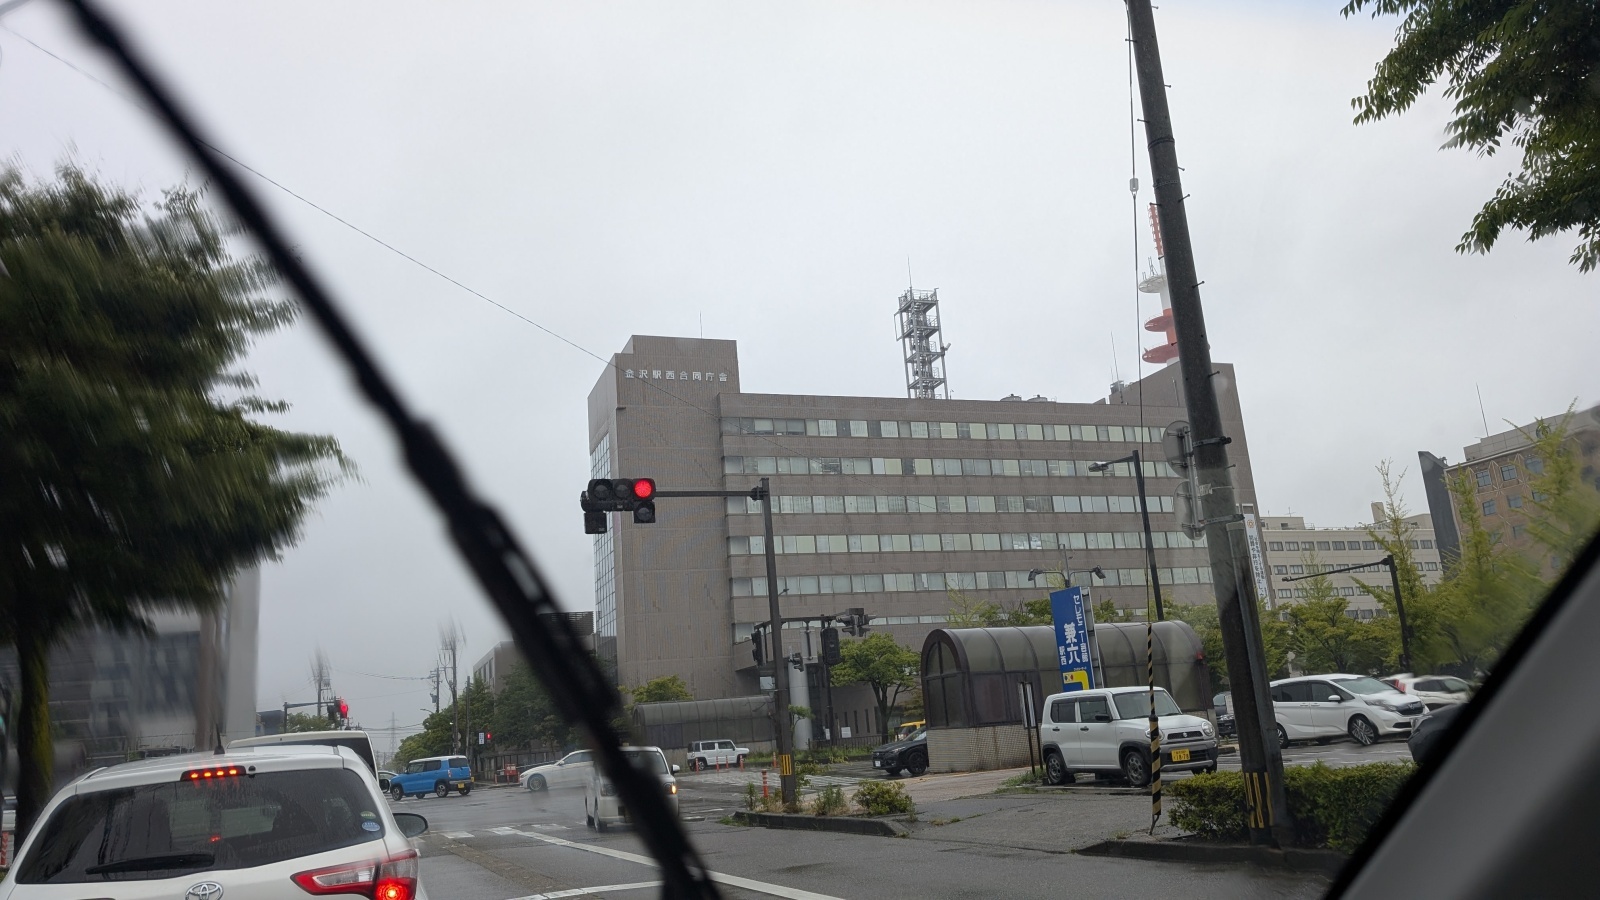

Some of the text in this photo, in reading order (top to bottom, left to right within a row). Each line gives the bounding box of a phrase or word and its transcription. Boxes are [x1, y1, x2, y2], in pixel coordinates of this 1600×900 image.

[625, 369, 728, 382] 金沢駅西合同庁舎
[1063, 622, 1081, 665] 兼六
[1073, 594, 1089, 663] セレモニー会館
